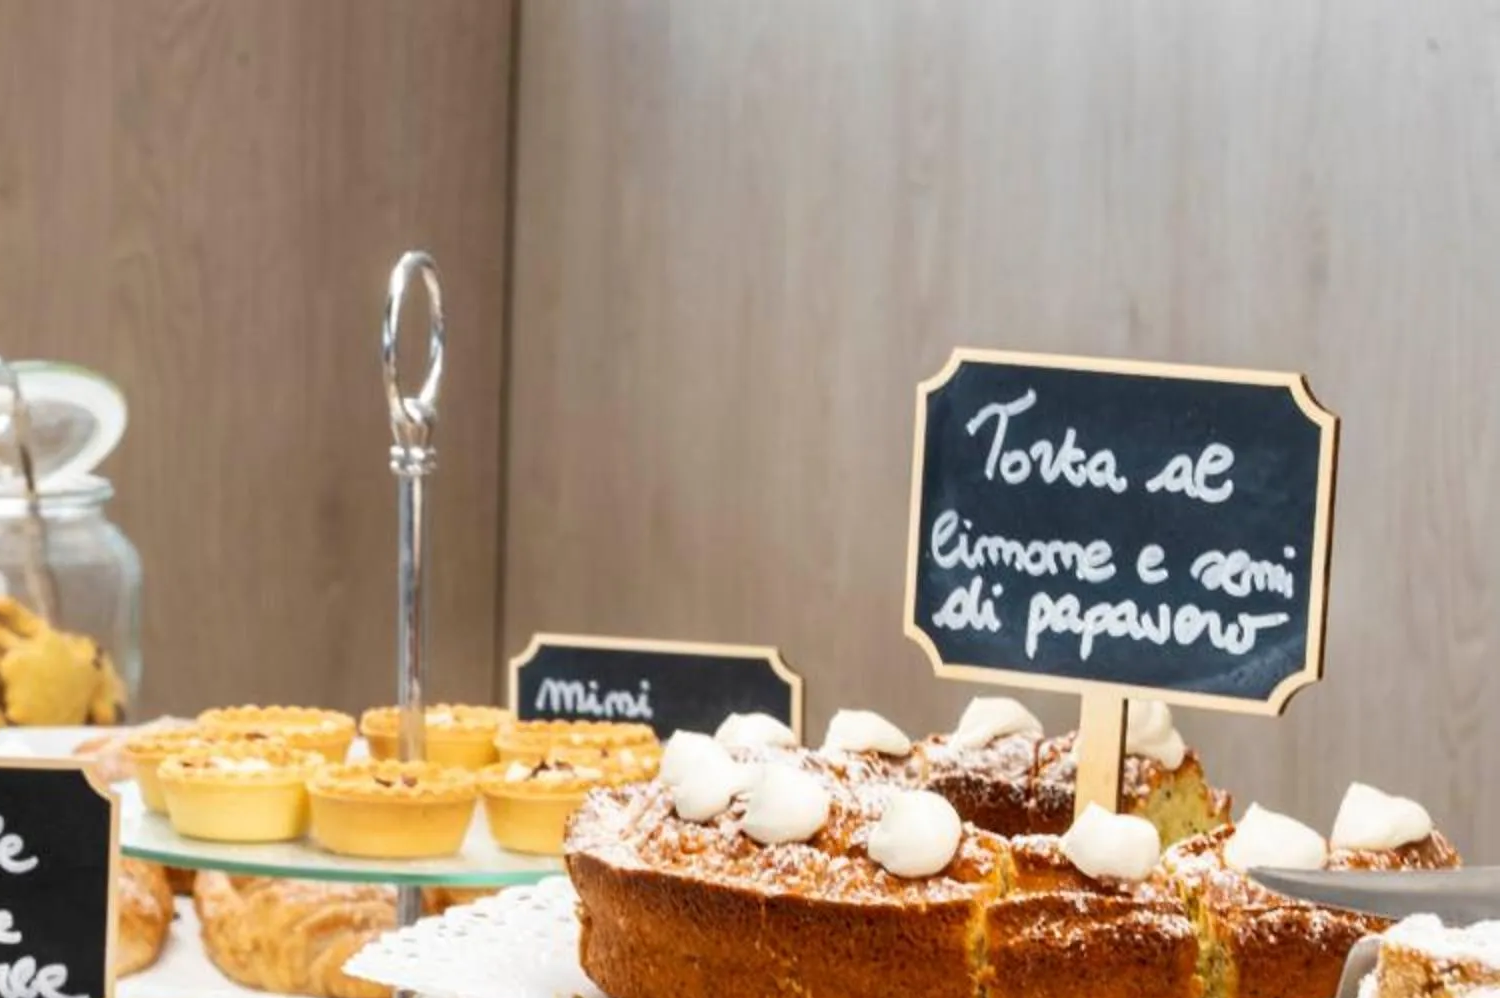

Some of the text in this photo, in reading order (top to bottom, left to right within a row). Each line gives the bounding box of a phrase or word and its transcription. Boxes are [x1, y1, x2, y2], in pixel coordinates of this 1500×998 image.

[1145, 442, 1235, 503] al
[930, 508, 1117, 582] limone
[1136, 543, 1169, 584] e
[931, 575, 1003, 632] di
